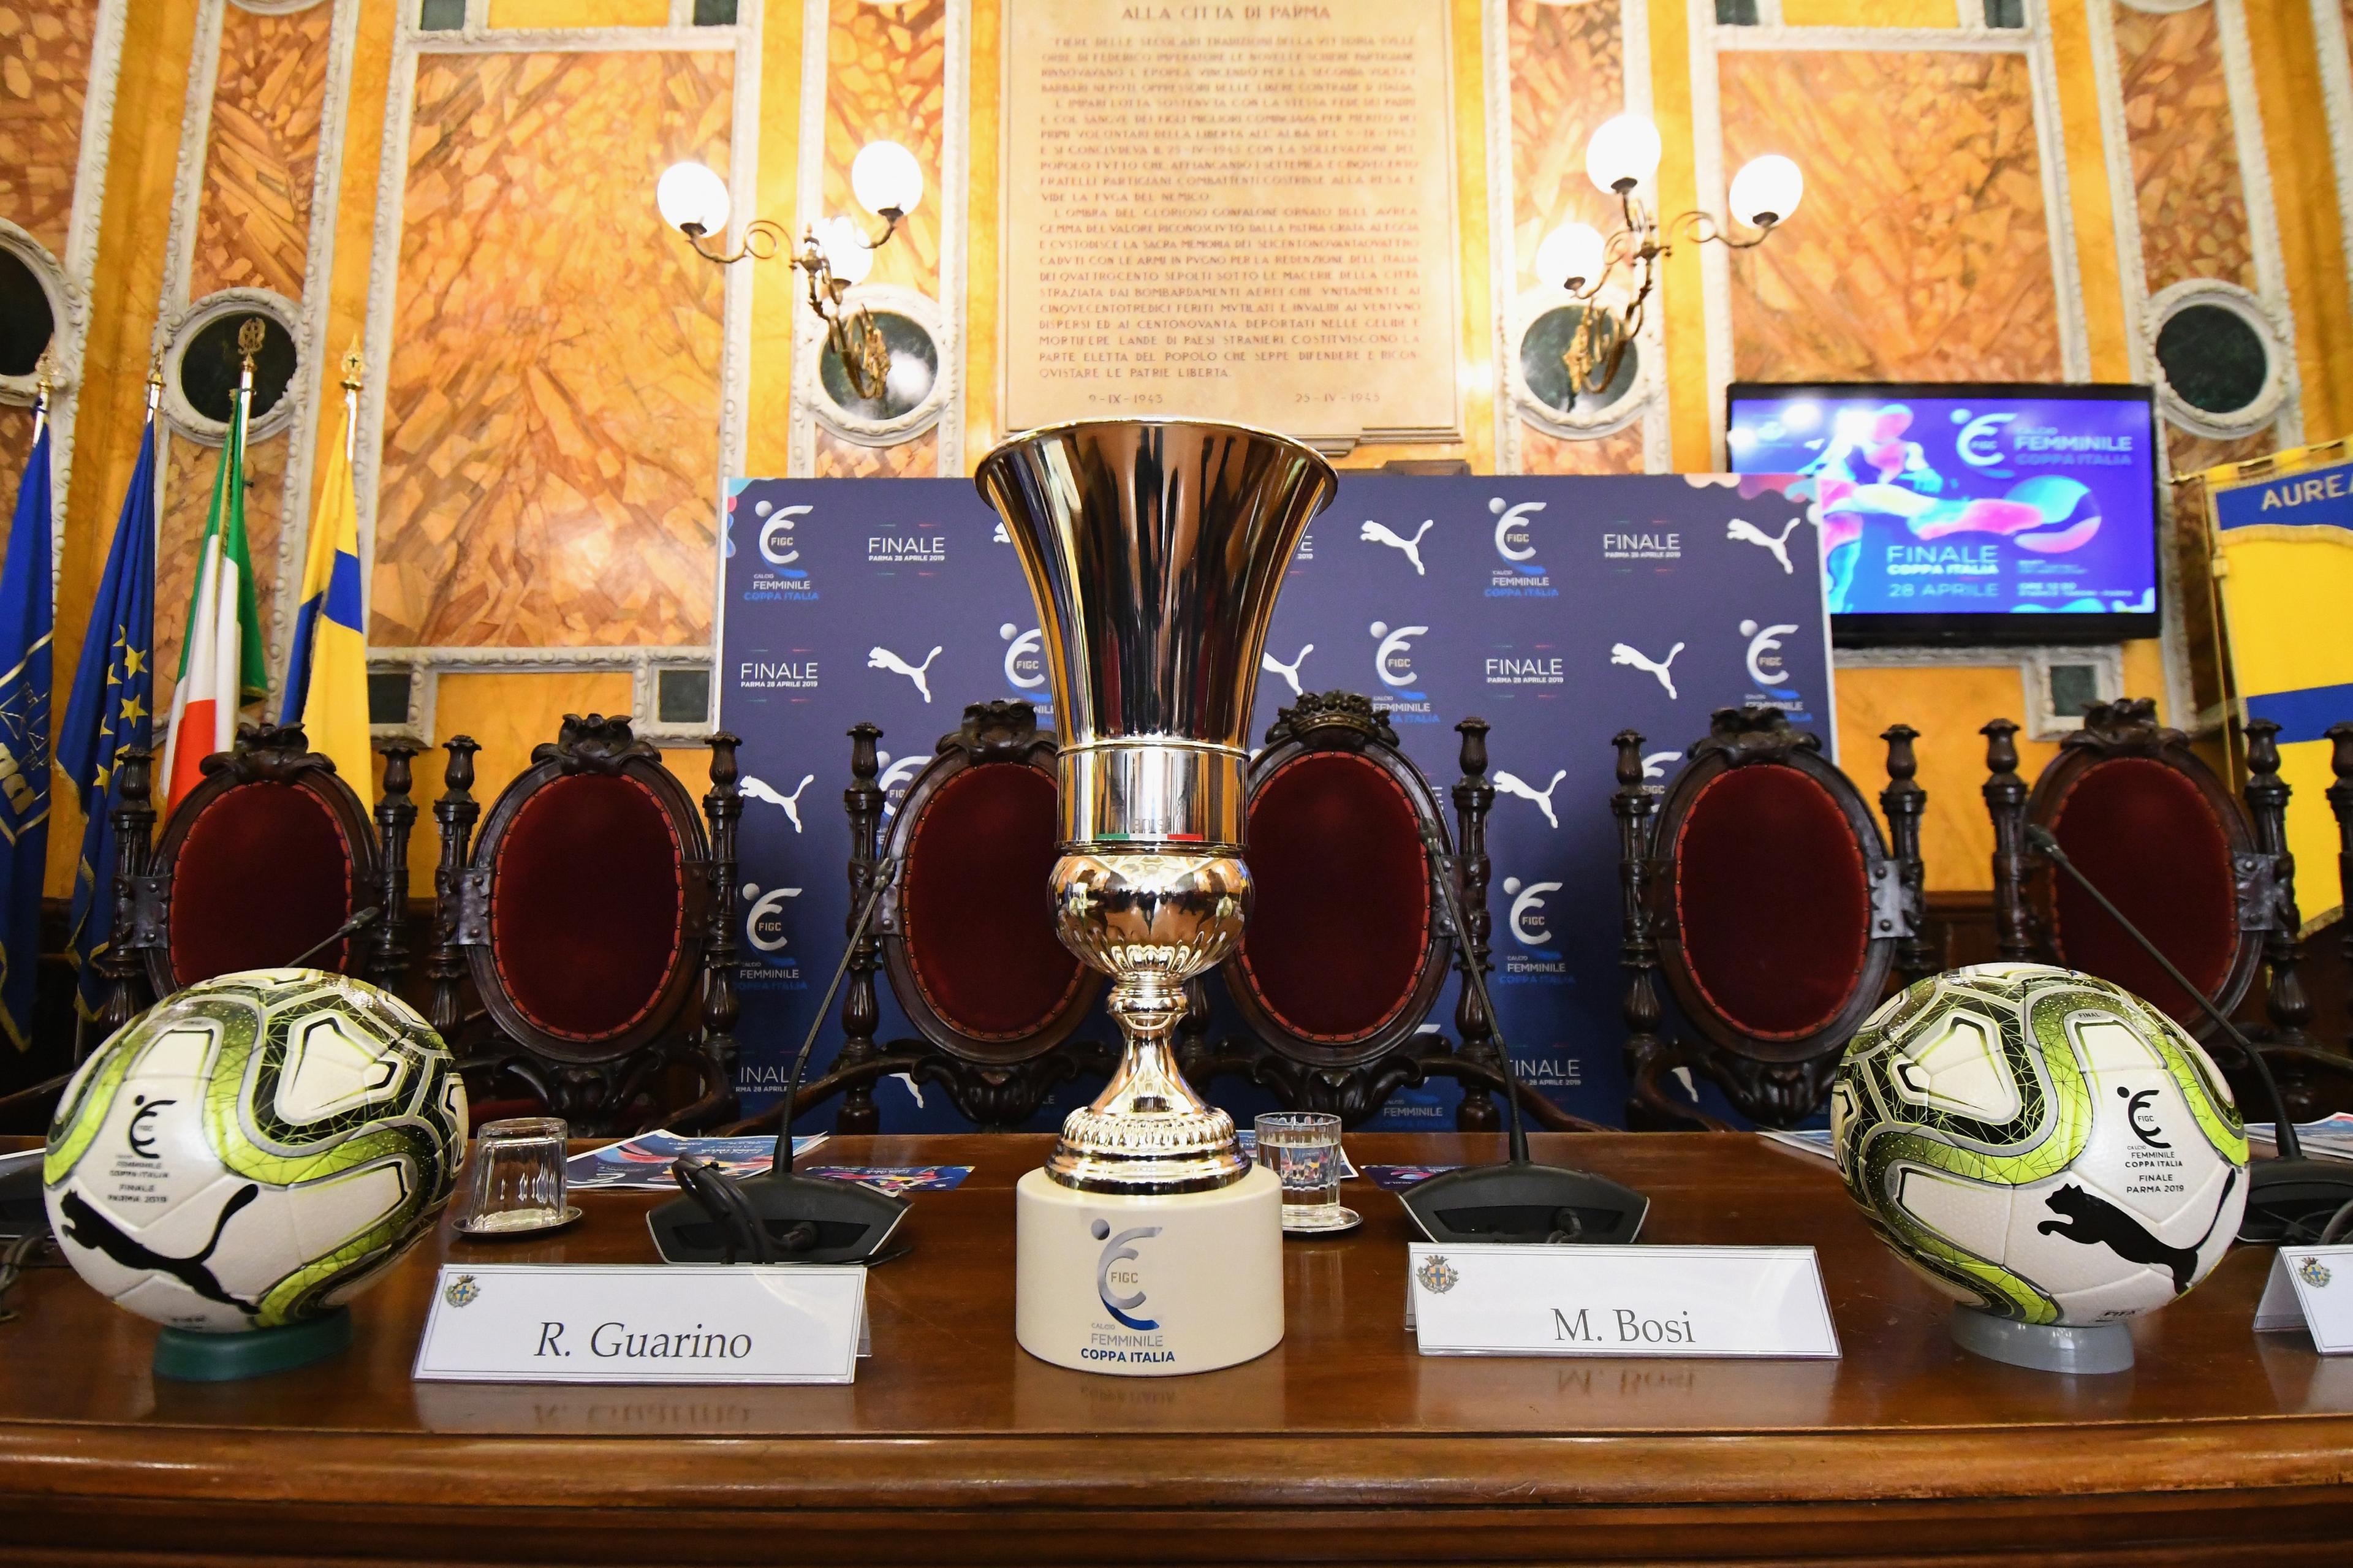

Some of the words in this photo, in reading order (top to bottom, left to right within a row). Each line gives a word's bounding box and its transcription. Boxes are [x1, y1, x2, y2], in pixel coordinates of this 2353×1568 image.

[1121, 6, 1170, 19] ALLA
[1245, 6, 1260, 19] DI
[1270, 6, 1330, 19] PARMA
[1039, 352, 1075, 362] PARTE
[1083, 352, 1128, 362] ELETTA
[1135, 352, 1156, 361] DEL
[1165, 352, 1217, 361] POPOLO
[1224, 351, 1245, 361] CHE
[1255, 351, 1289, 361] SEPPE
[1298, 351, 1359, 360] DIFENDERE
[1367, 350, 1374, 360] E
[1039, 368, 1099, 378] QVISTARE
[1107, 368, 1121, 377] LE
[1131, 368, 1170, 377] PATRIE
[2014, 436, 2132, 452] FEMMINILE
[2261, 471, 2353, 512] AURE
[771, 537, 793, 546] FIGC
[1507, 534, 1529, 542] FIGC
[1604, 534, 1681, 550] FINALE
[869, 537, 945, 553] FINALE
[1887, 545, 1999, 563] FINALE
[753, 580, 811, 590] FEMMINILE
[1493, 577, 1550, 586] FEMMINILE
[1889, 583, 1915, 597] 28
[1920, 583, 1999, 597] APRILE
[744, 592, 782, 601] COPPA
[784, 592, 819, 600] ITALIA
[1016, 661, 1039, 669] FIGC
[1388, 659, 1411, 667] FIGC
[1486, 659, 1563, 675] FINALE
[741, 662, 818, 679] FINALE
[1373, 703, 1430, 712] FEMMINILE
[889, 789, 905, 798] FIG
[759, 922, 781, 931] FIGC
[1522, 916, 1545, 925] FIGC
[740, 969, 799, 979] FEMMINILE
[1507, 963, 1566, 973] FEMMINILE
[1510, 1059, 1581, 1077] INALE
[1384, 1107, 1443, 1117] FEMMINILE
[1110, 1272, 1139, 1284] FIGC
[1550, 1308, 1602, 1342] M.
[1612, 1308, 1696, 1343] Bosi
[533, 1321, 571, 1357] R.
[590, 1322, 752, 1359] Guarino
[1091, 1333, 1164, 1347] FEMMINILE
[1080, 1347, 1126, 1362] COPPA
[1130, 1350, 1175, 1362] ITALIA
